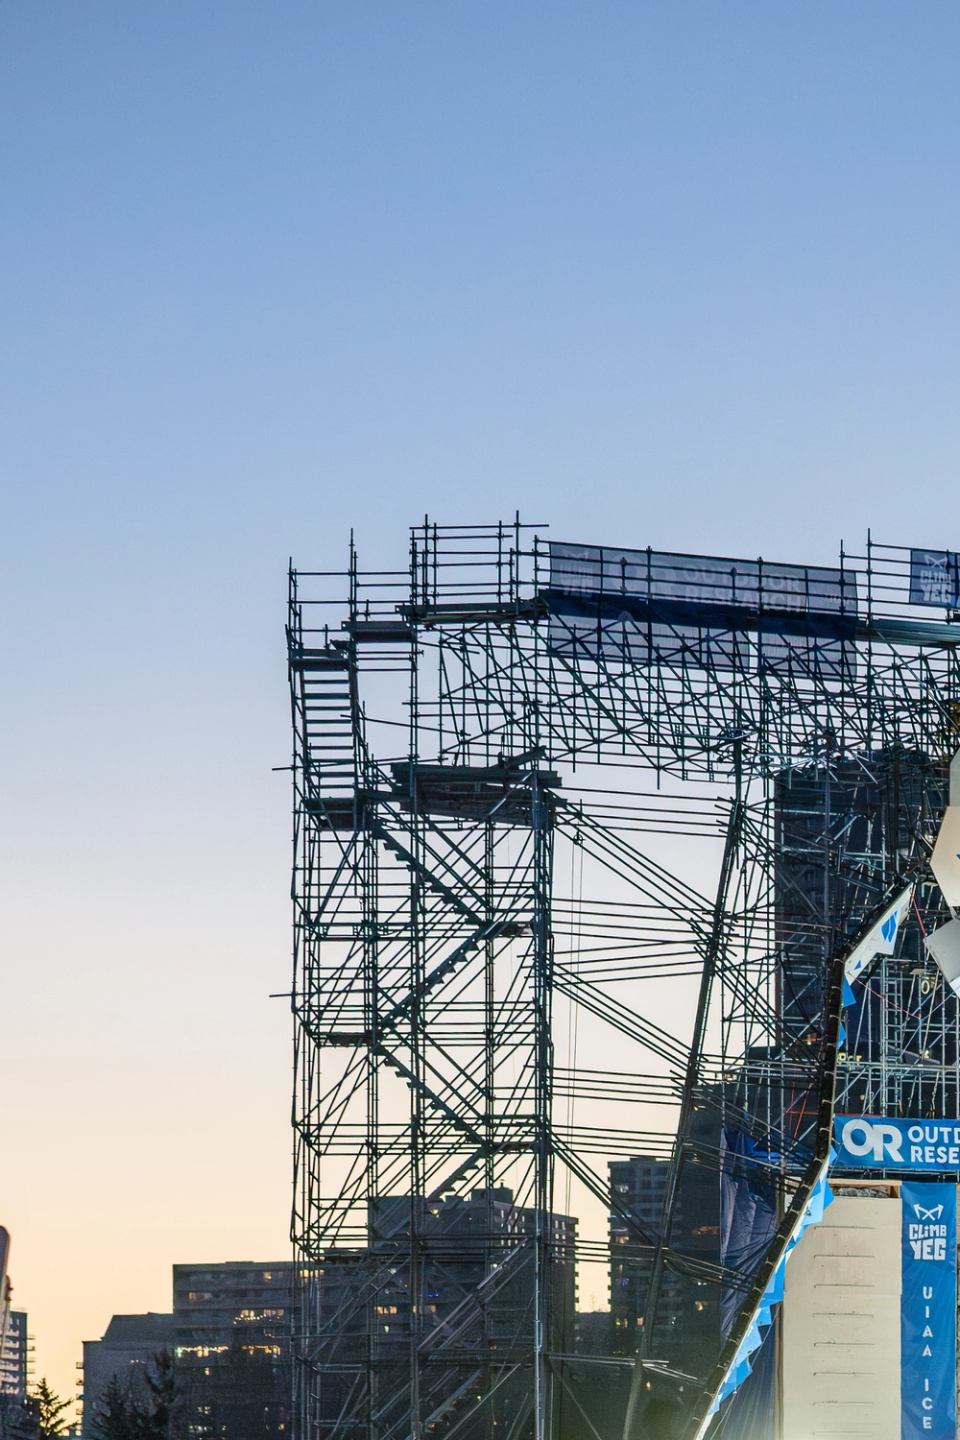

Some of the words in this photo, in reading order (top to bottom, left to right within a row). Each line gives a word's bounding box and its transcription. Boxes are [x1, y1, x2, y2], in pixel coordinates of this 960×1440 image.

[842, 1119, 905, 1162] OR
[909, 1238, 947, 1261] YEG
[921, 1285, 934, 1357] UIAA
[921, 1378, 934, 1430] ICE
